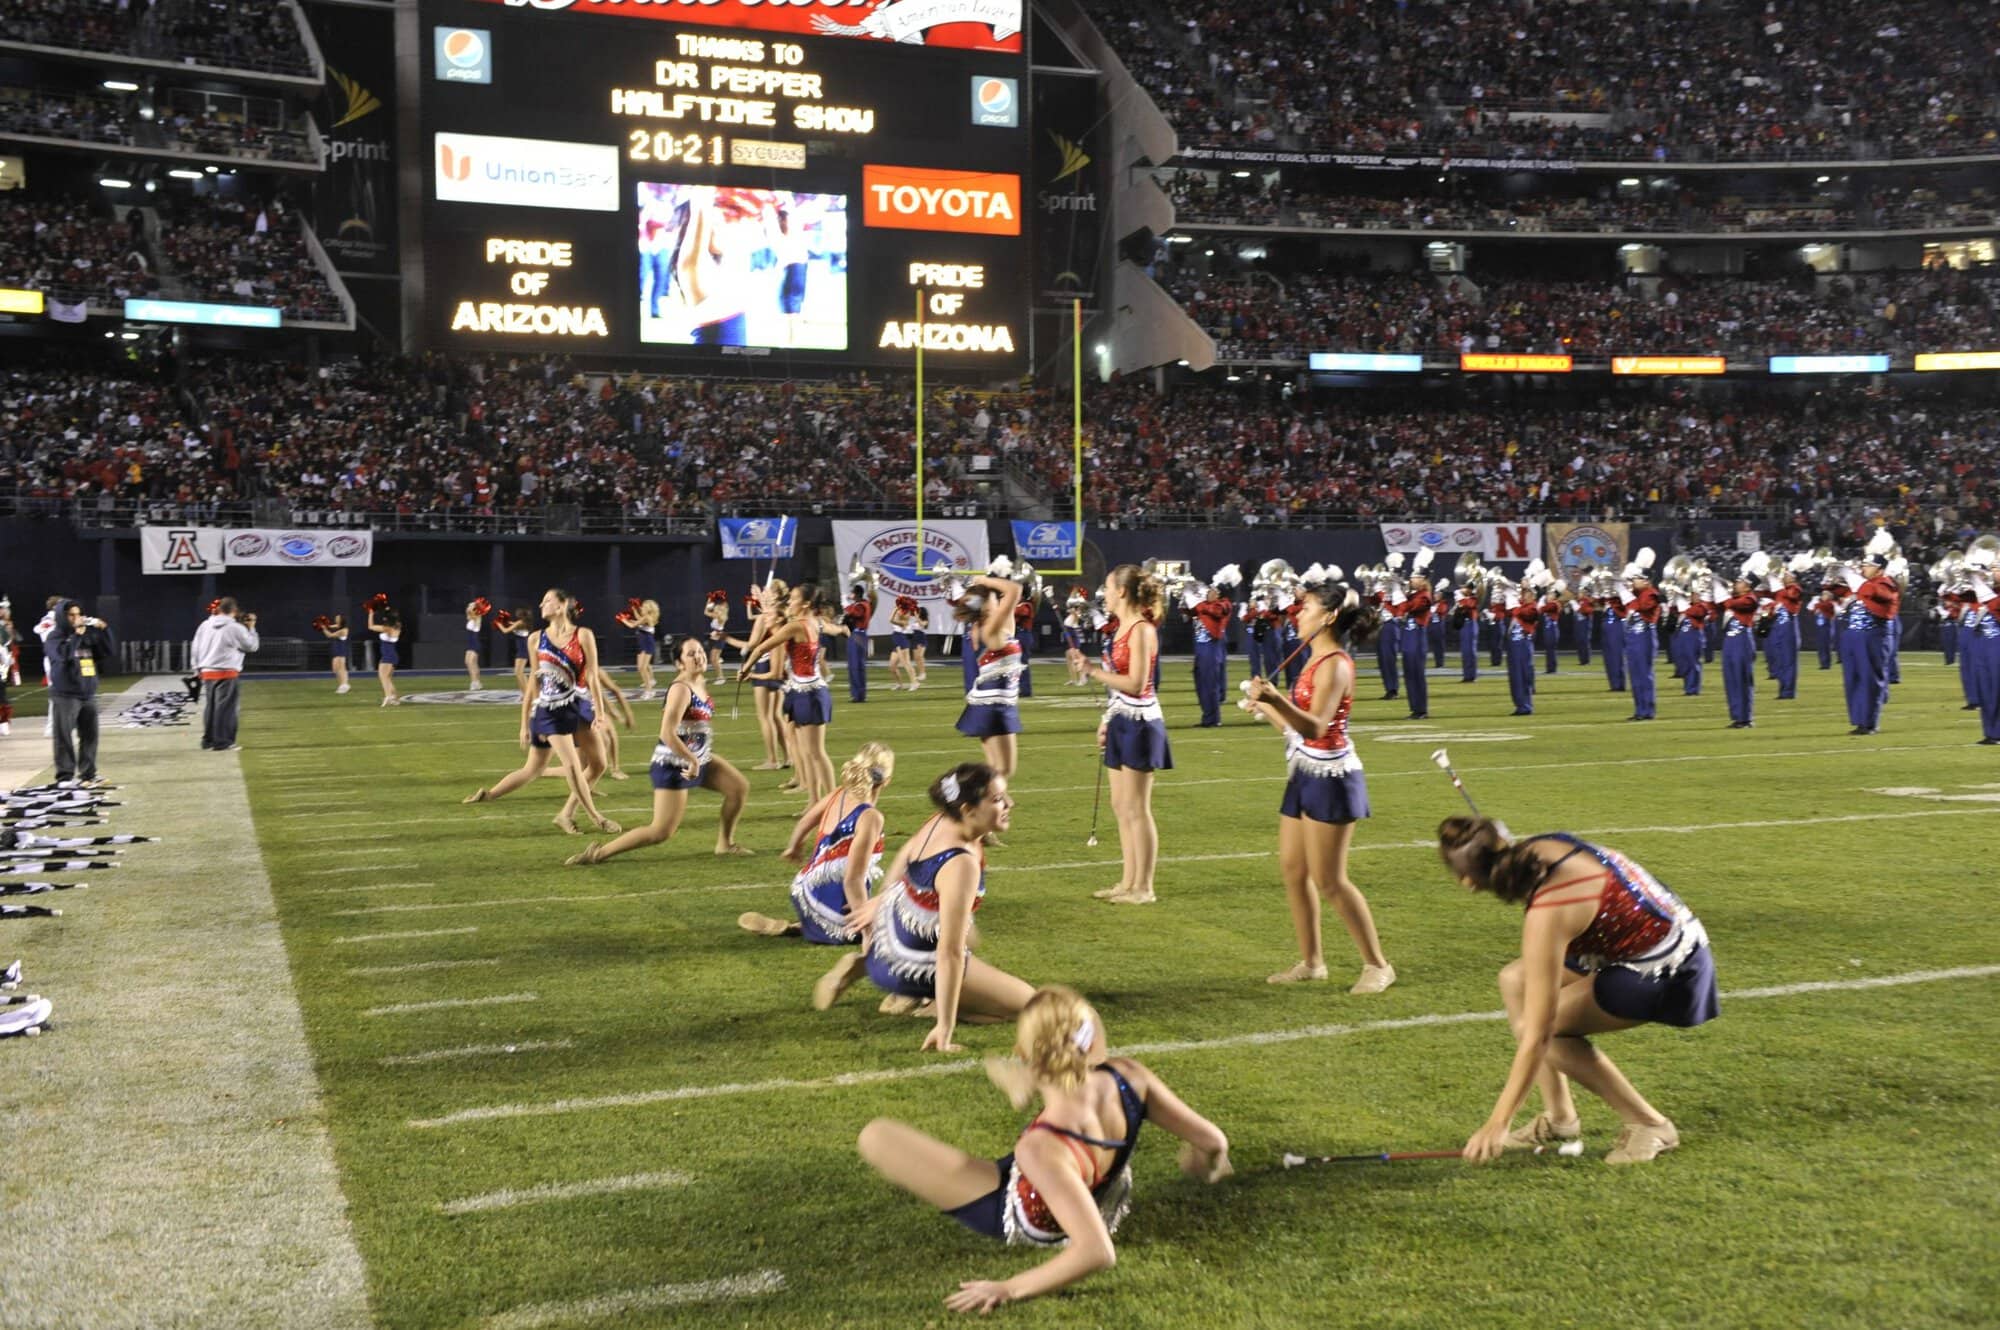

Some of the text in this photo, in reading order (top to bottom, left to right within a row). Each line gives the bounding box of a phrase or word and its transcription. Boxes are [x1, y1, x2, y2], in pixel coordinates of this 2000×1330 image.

[675, 34, 805, 65] THANKS TO
[655, 60, 823, 99] DR PEPPER
[611, 89, 874, 133] HALFTIME SHOW
[629, 130, 724, 165] 20:21
[733, 144, 804, 162] SYCUAN
[871, 184, 1013, 220] TOYOTA
[1037, 190, 1097, 214] Sprint
[486, 238, 572, 267] PRIDE
[511, 271, 549, 296] OF
[909, 262, 984, 288] PRIDE
[451, 301, 608, 336] ARIZONA
[930, 293, 964, 315] OF
[878, 321, 1015, 352] ARIZONA
[162, 531, 207, 570] A
[924, 532, 953, 553] LIFE
[1496, 526, 1528, 558] N
